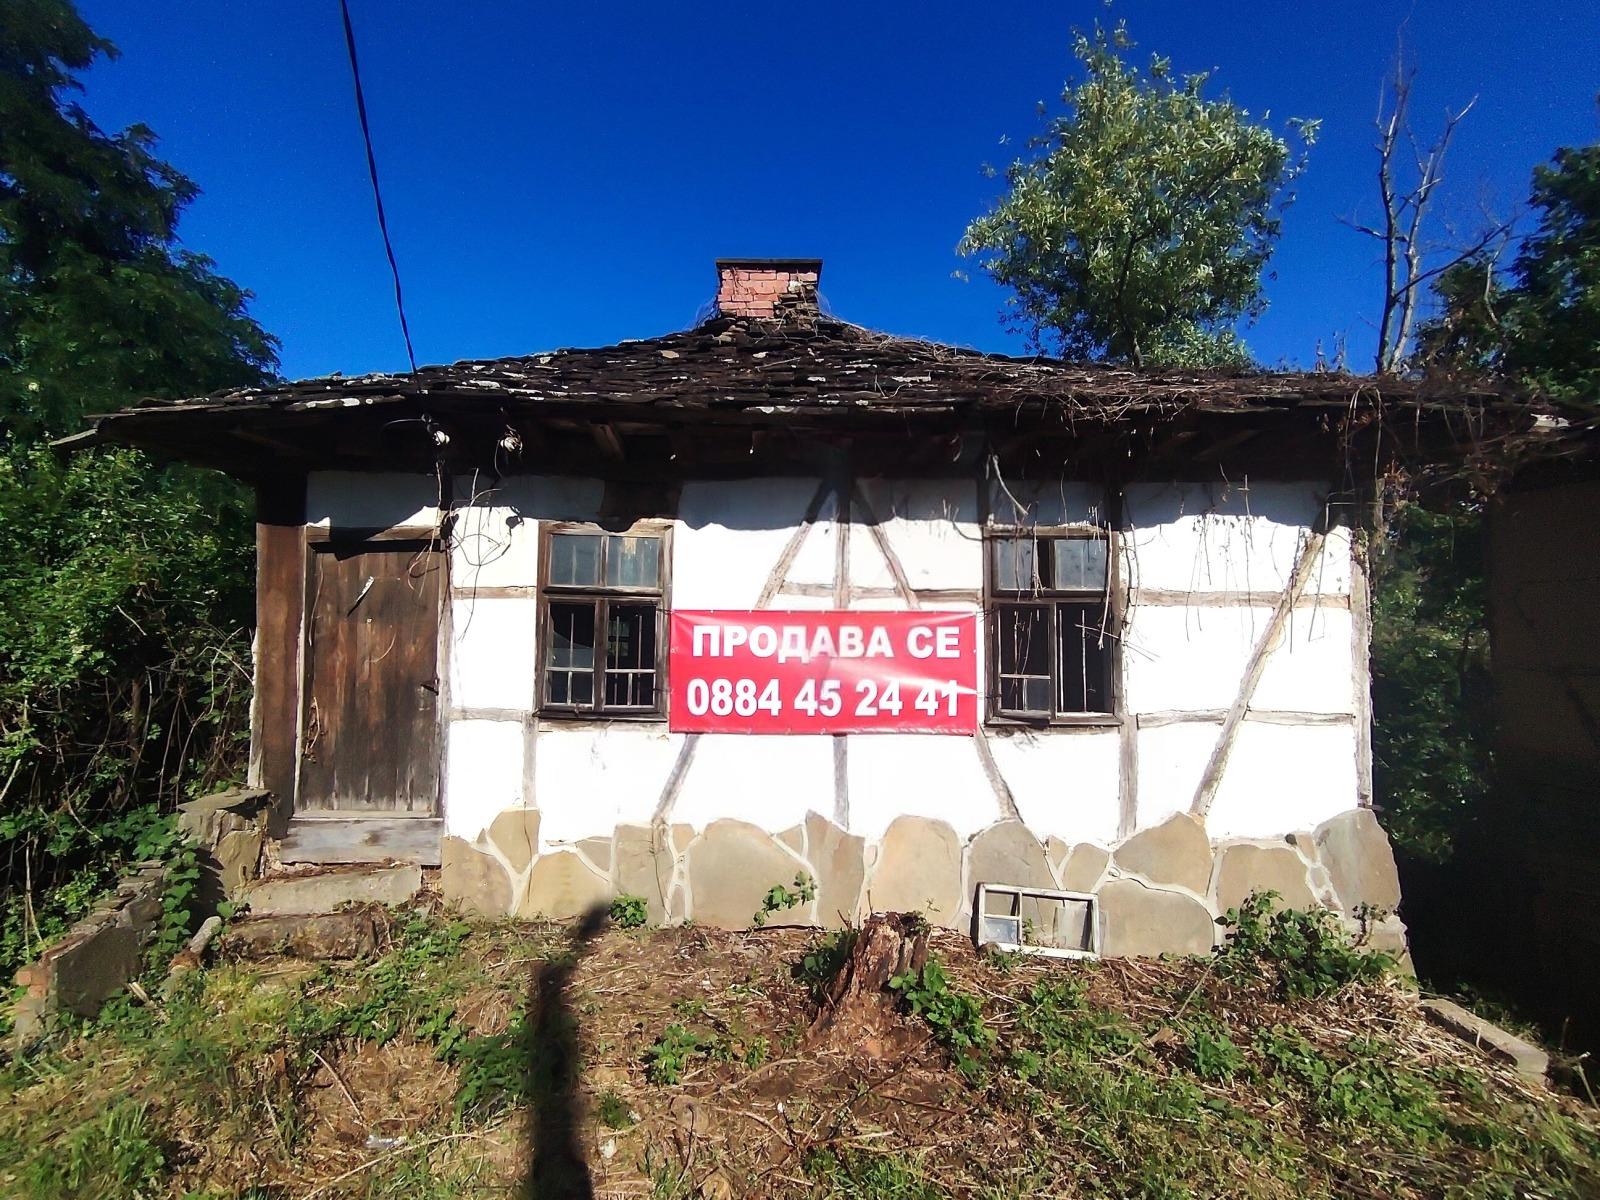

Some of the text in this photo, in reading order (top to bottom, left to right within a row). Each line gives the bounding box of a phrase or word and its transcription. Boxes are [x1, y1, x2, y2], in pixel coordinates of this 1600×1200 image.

[692, 625, 961, 663] ПРОДАВА СЕ
[687, 678, 959, 717] 0884 45 24 41
